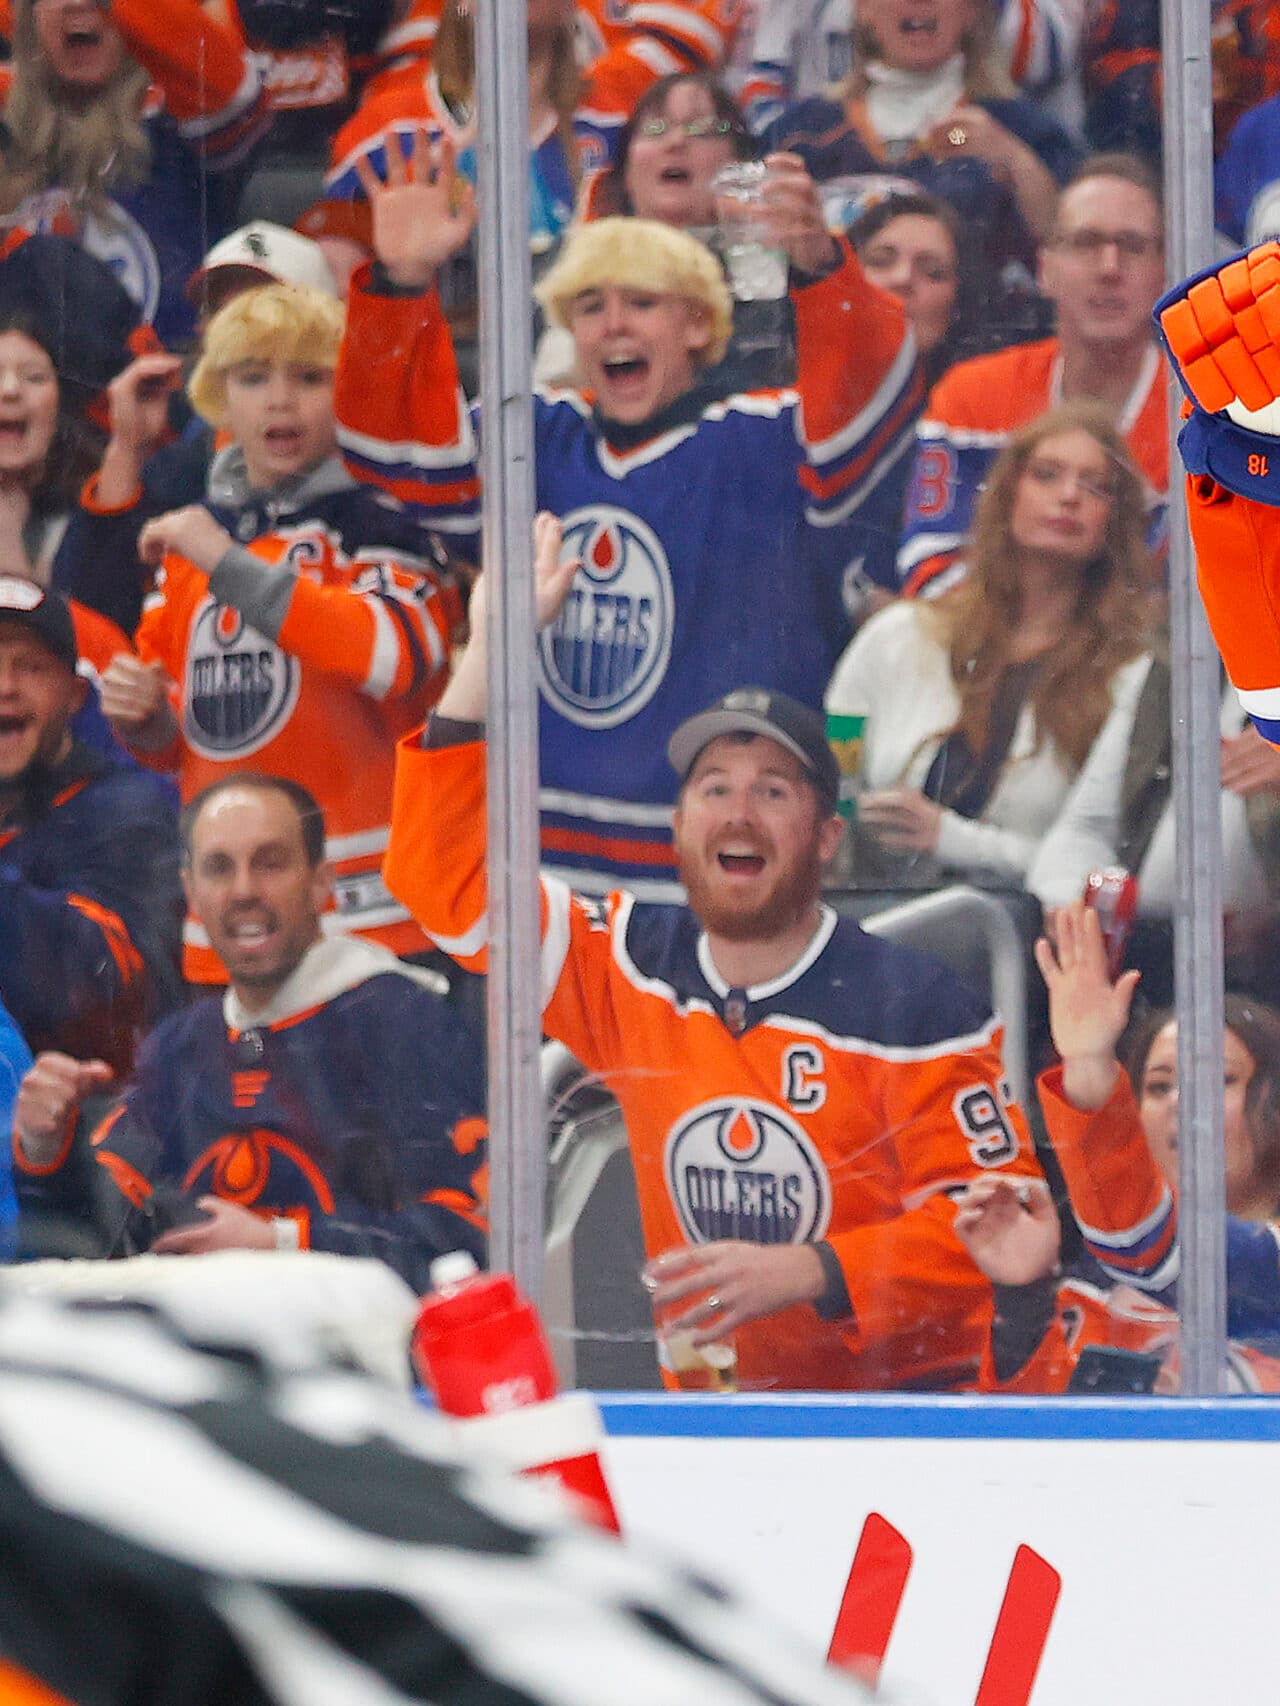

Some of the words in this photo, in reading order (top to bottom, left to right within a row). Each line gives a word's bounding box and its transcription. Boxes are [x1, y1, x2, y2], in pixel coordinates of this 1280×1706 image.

[1247, 453, 1270, 478] 18
[784, 1045, 824, 1110] C
[957, 1079, 1016, 1166] 9
[684, 1165, 801, 1244] OILERS
